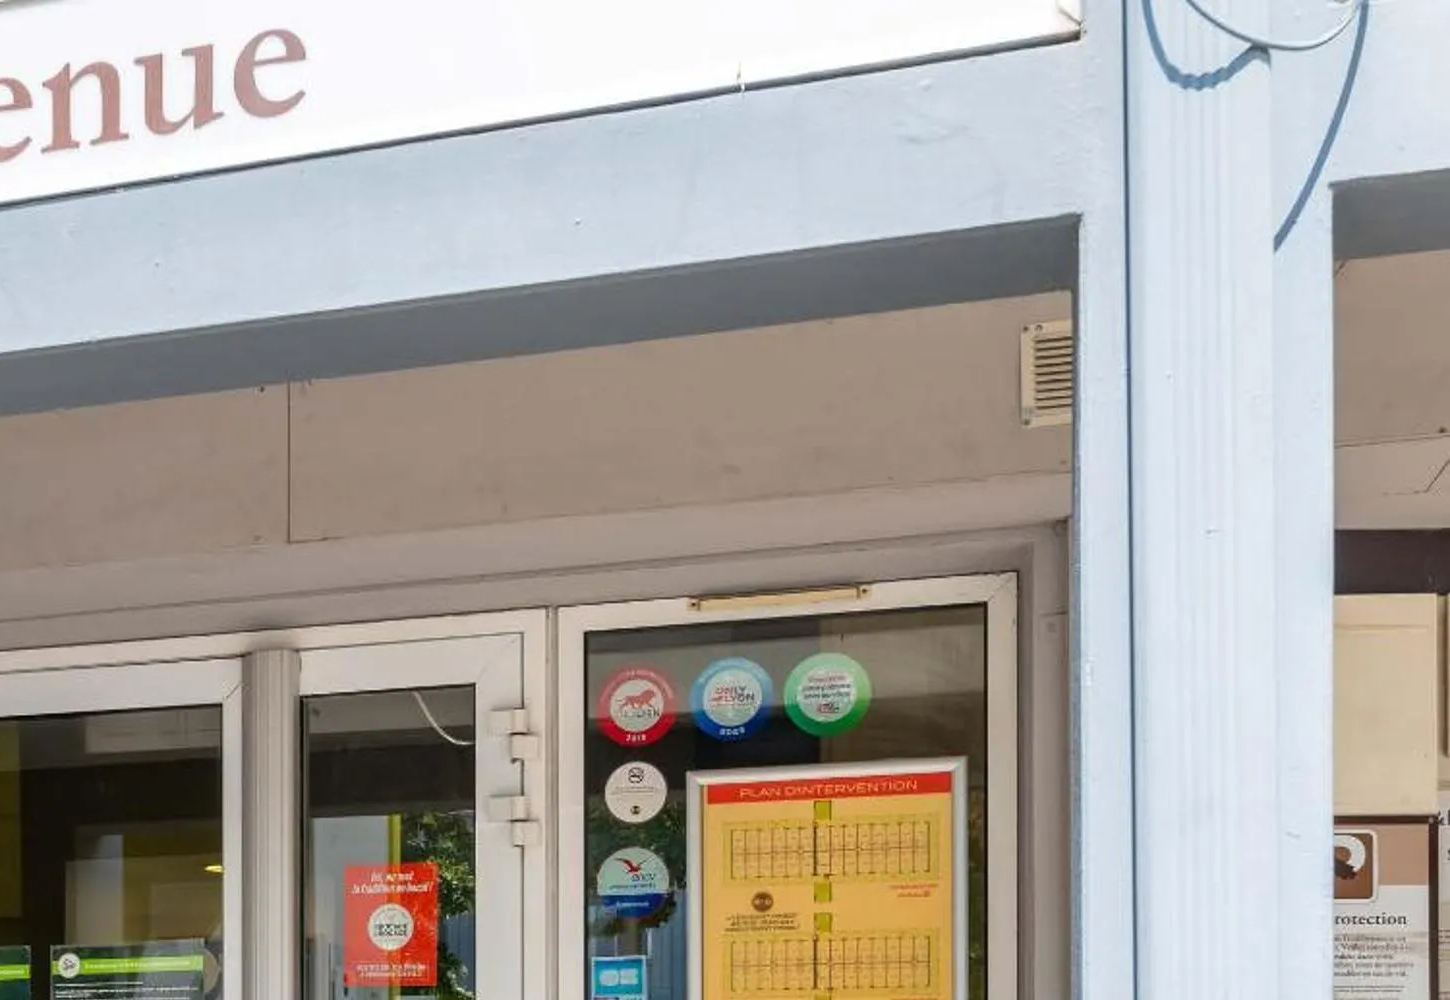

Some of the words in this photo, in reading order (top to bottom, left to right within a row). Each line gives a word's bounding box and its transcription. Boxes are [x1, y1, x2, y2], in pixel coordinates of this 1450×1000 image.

[739, 787, 782, 799] PLAN
[786, 779, 918, 796] D'INTERVENTION
[1334, 910, 1408, 926] rotection
